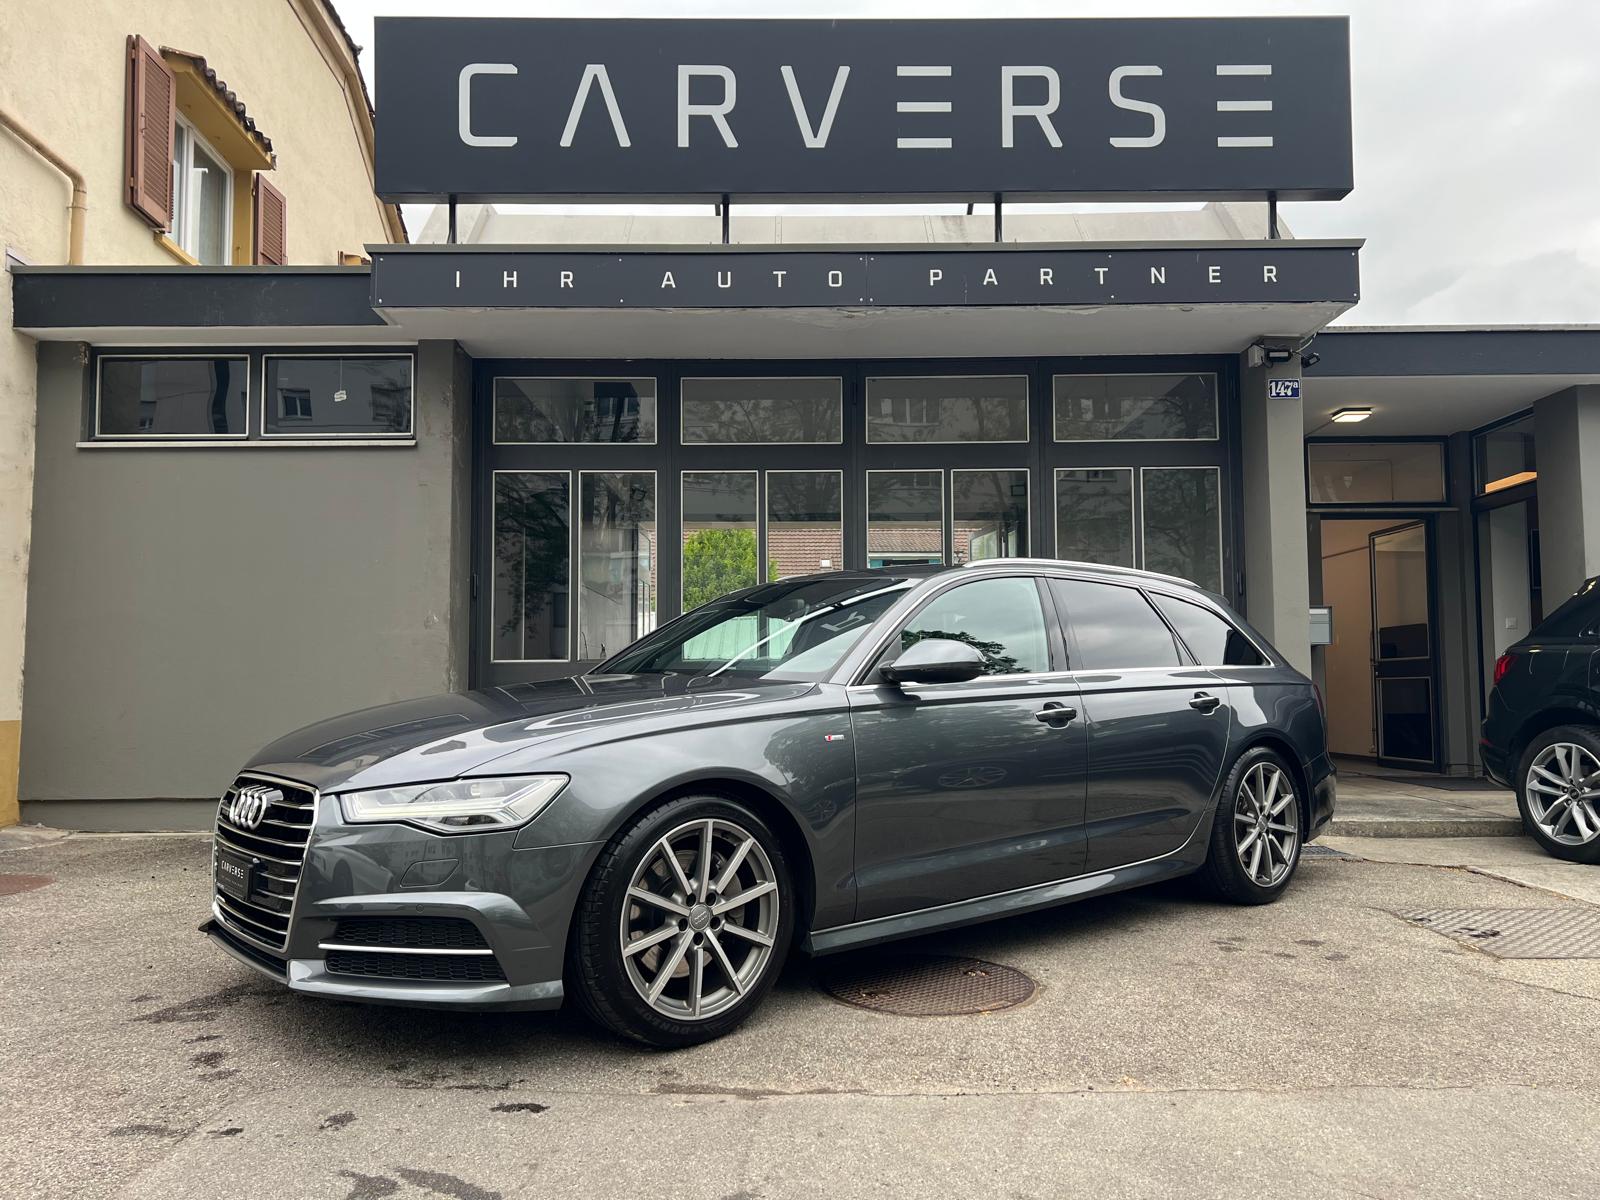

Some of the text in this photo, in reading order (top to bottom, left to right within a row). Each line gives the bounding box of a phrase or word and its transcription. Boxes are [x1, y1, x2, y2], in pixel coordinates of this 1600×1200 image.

[458, 63, 1274, 149] CARVERSE
[455, 265, 1278, 290] IHR AUTO PARTNER
[1270, 381, 1298, 396] 147a
[221, 860, 244, 879] CARVERSE
